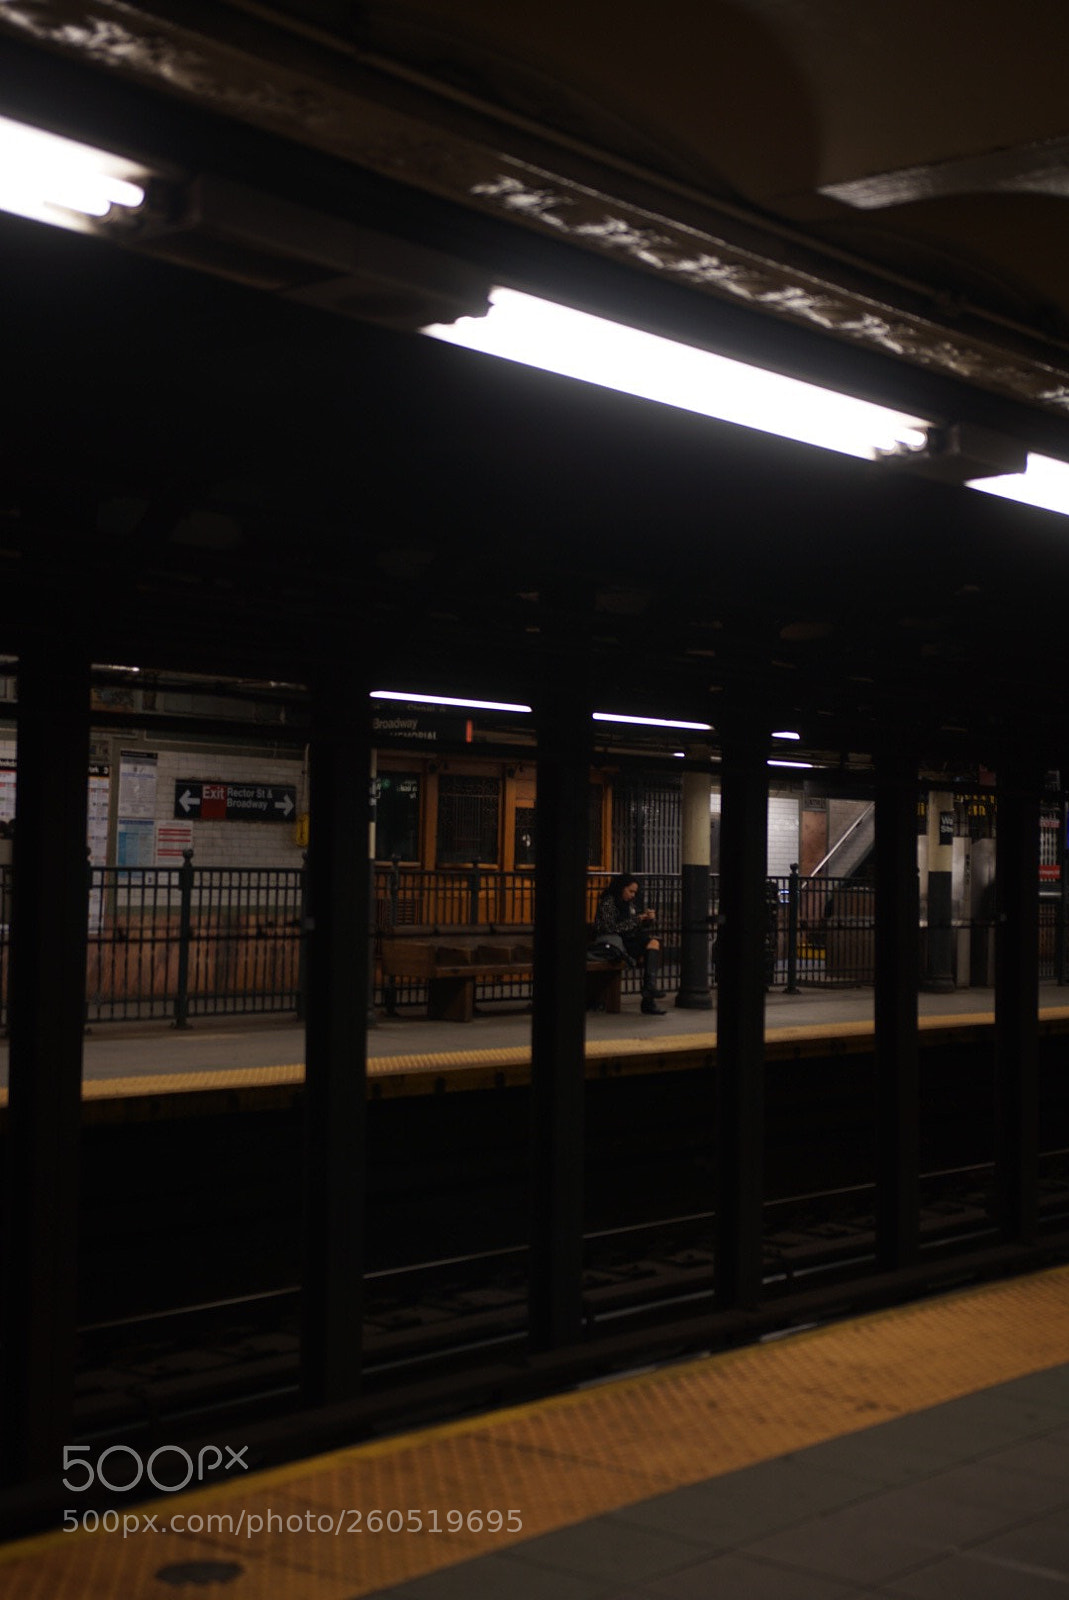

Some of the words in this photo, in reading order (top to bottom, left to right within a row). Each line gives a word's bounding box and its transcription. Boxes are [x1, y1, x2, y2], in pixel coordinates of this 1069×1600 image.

[372, 717, 418, 730] Broadway
[202, 786, 225, 800] Exit
[227, 787, 255, 798] Rector
[256, 788, 266, 799] St
[267, 788, 273, 799] &
[226, 798, 268, 811] Broadway
